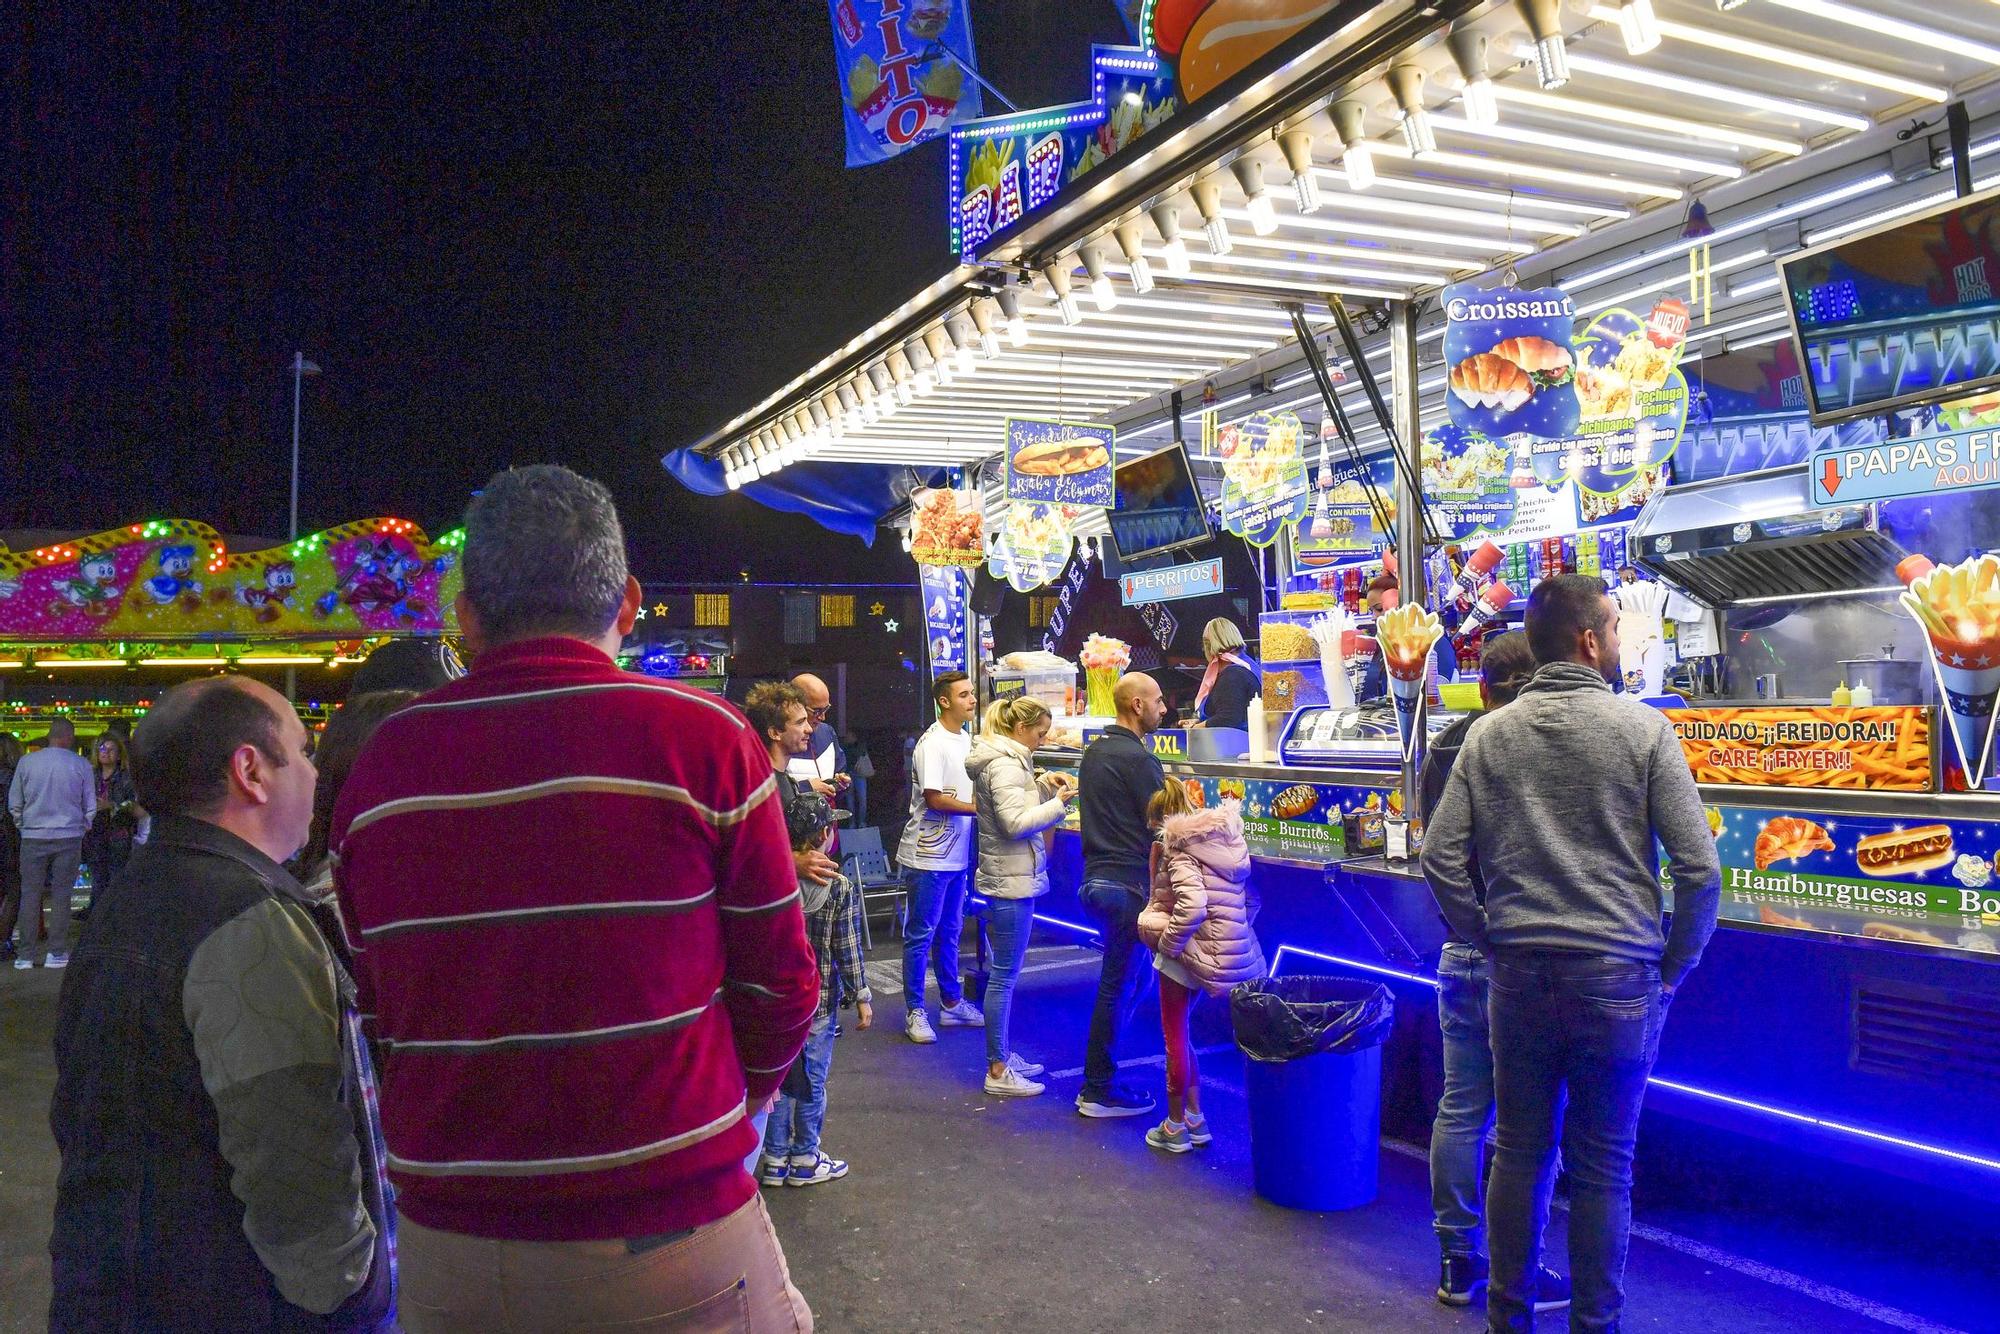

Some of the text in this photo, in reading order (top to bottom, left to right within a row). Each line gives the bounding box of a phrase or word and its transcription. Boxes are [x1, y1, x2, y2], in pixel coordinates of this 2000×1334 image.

[1447, 295, 1573, 322] Croissant
[1653, 311, 1686, 334] NUEVO
[1635, 387, 1684, 406] Pechuga
[1642, 402, 1675, 419] papas
[1578, 417, 1635, 436] alchipapas
[1845, 437, 1958, 479] PAPAS
[1329, 508, 1343, 517] CON
[1466, 512, 1497, 524] elegir
[1315, 537, 1352, 549] XXL
[1135, 565, 1211, 590] PERRITOS
[1673, 721, 1896, 746] CUIDADO ¡¡FREIDORA!!
[1153, 735, 1181, 755] XXL
[1708, 749, 1852, 772] CARE ¡¡FRYER!!
[1244, 821, 1269, 834] apas
[1730, 867, 1927, 908] Hamburguesas
